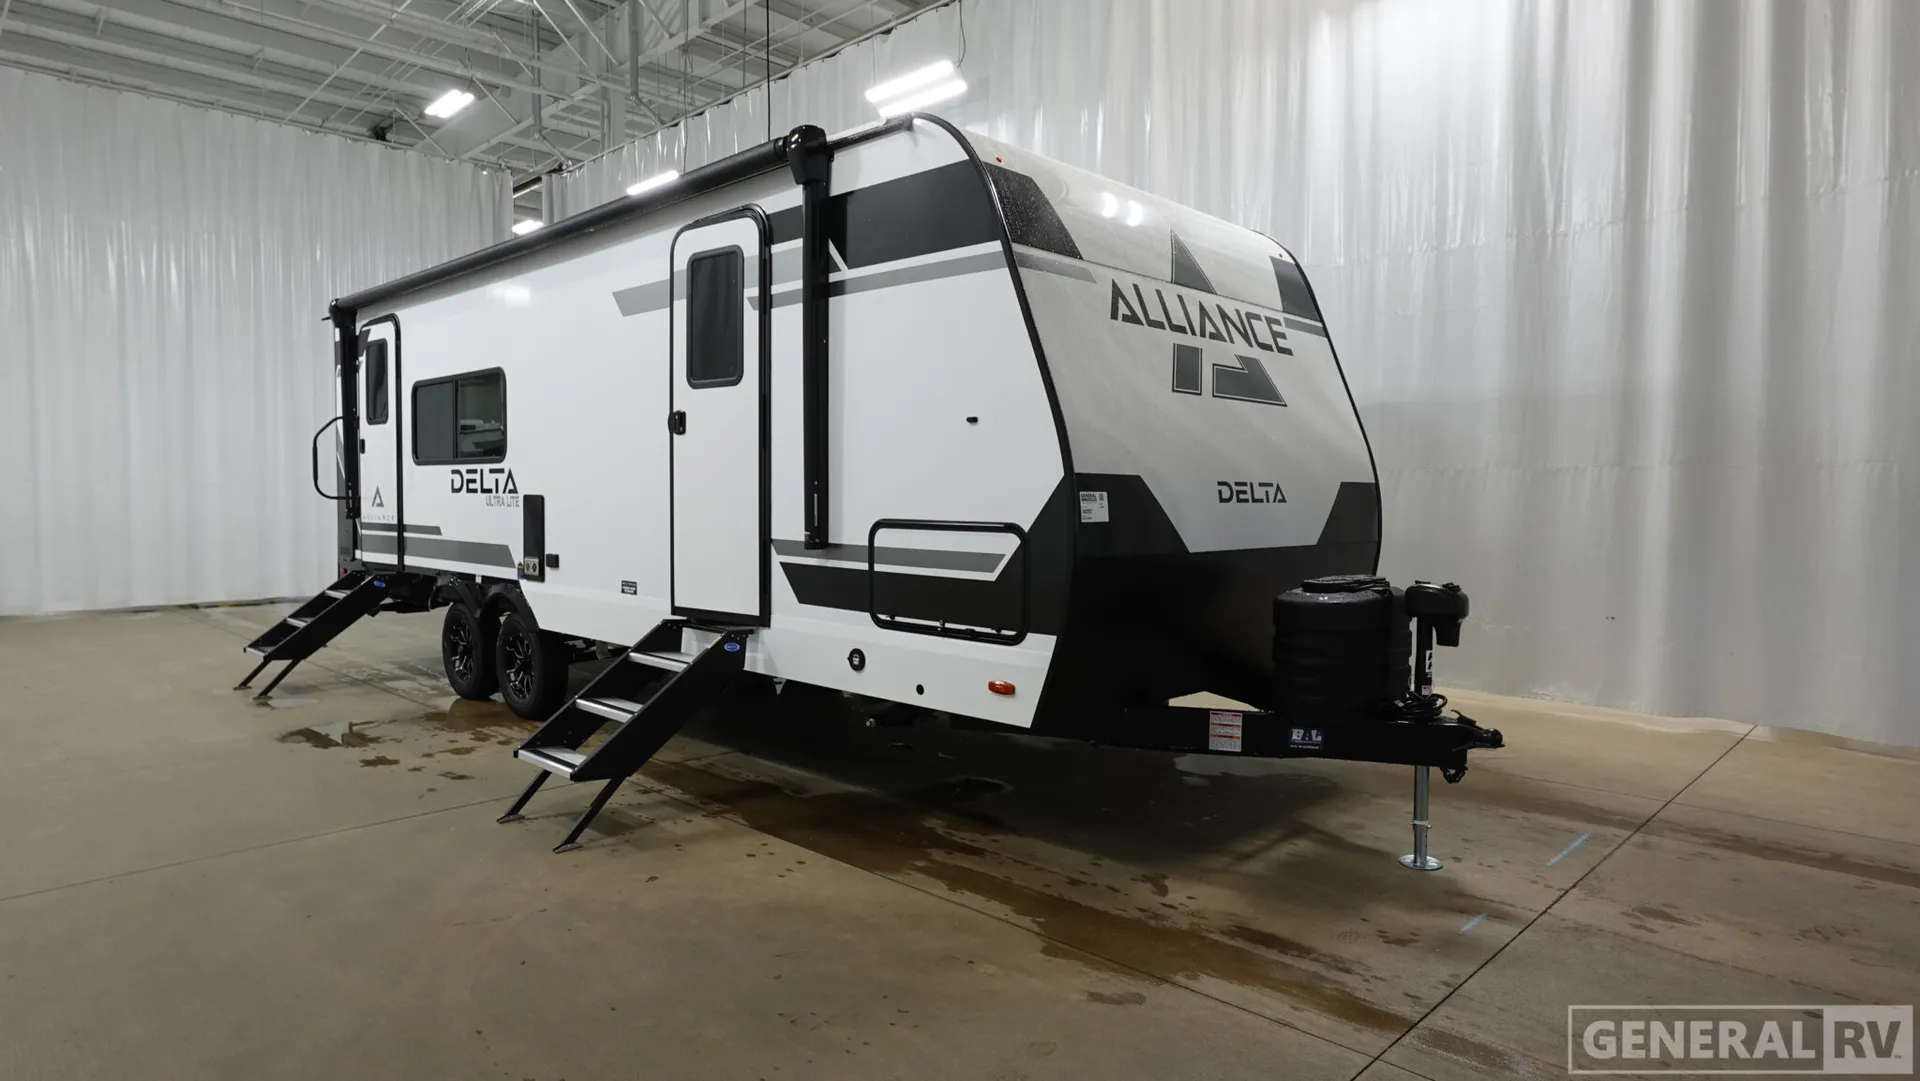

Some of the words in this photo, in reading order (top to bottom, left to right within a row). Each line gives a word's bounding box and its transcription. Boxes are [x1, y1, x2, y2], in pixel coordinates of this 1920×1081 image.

[1110, 278, 1294, 356] ALLIANCE
[451, 468, 519, 494] DELTA
[1217, 481, 1287, 504] DELTA
[486, 495, 505, 507] ULTRA
[506, 495, 520, 508] LITE
